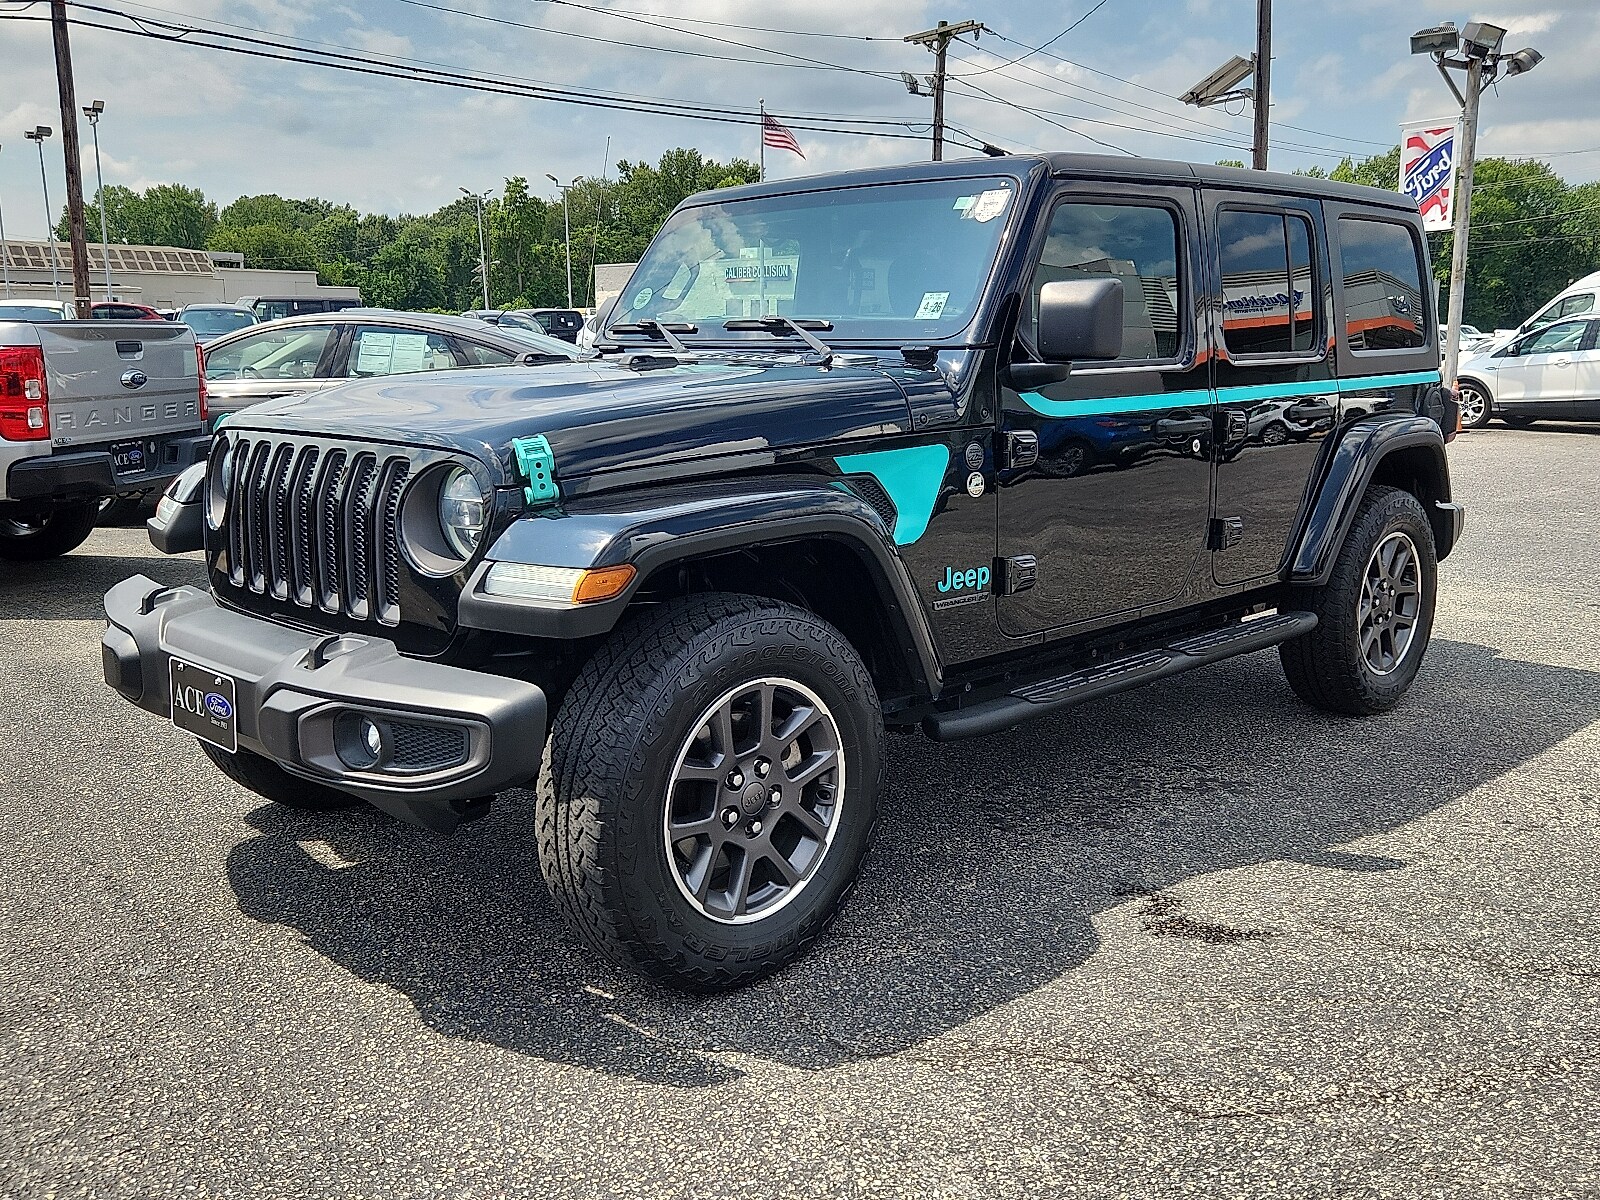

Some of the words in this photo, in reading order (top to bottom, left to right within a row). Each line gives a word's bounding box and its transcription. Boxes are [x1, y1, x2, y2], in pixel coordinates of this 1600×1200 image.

[1403, 148, 1452, 201] Ford
[724, 266, 751, 279] CALIBER
[752, 264, 789, 278] COLISION
[55, 400, 199, 430] RANGER
[113, 452, 129, 466] ACE
[937, 565, 990, 593] Jeep
[174, 682, 205, 717] ACE
[209, 696, 228, 716] Ford
